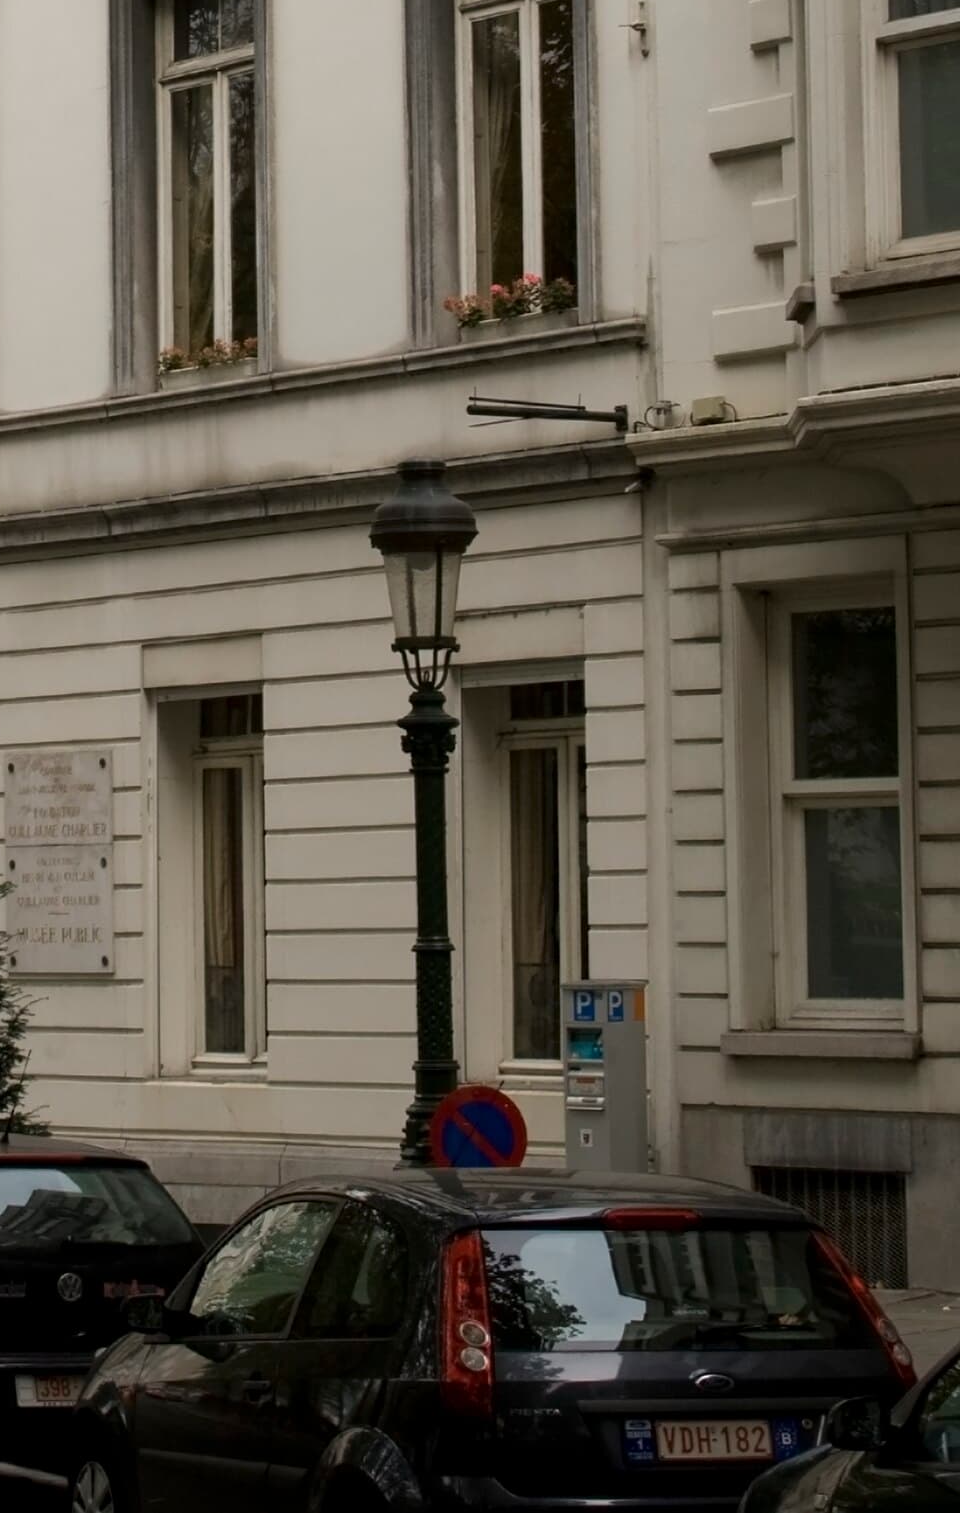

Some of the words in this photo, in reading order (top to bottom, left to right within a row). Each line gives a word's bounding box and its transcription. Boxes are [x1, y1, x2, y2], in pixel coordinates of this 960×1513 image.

[62, 823, 107, 837] CHARLIER
[62, 925, 104, 943] PUBLIC
[576, 992, 591, 1014] P
[609, 992, 622, 1016] P
[663, 1426, 767, 1454] VDH-182
[781, 1432, 792, 1446] B
